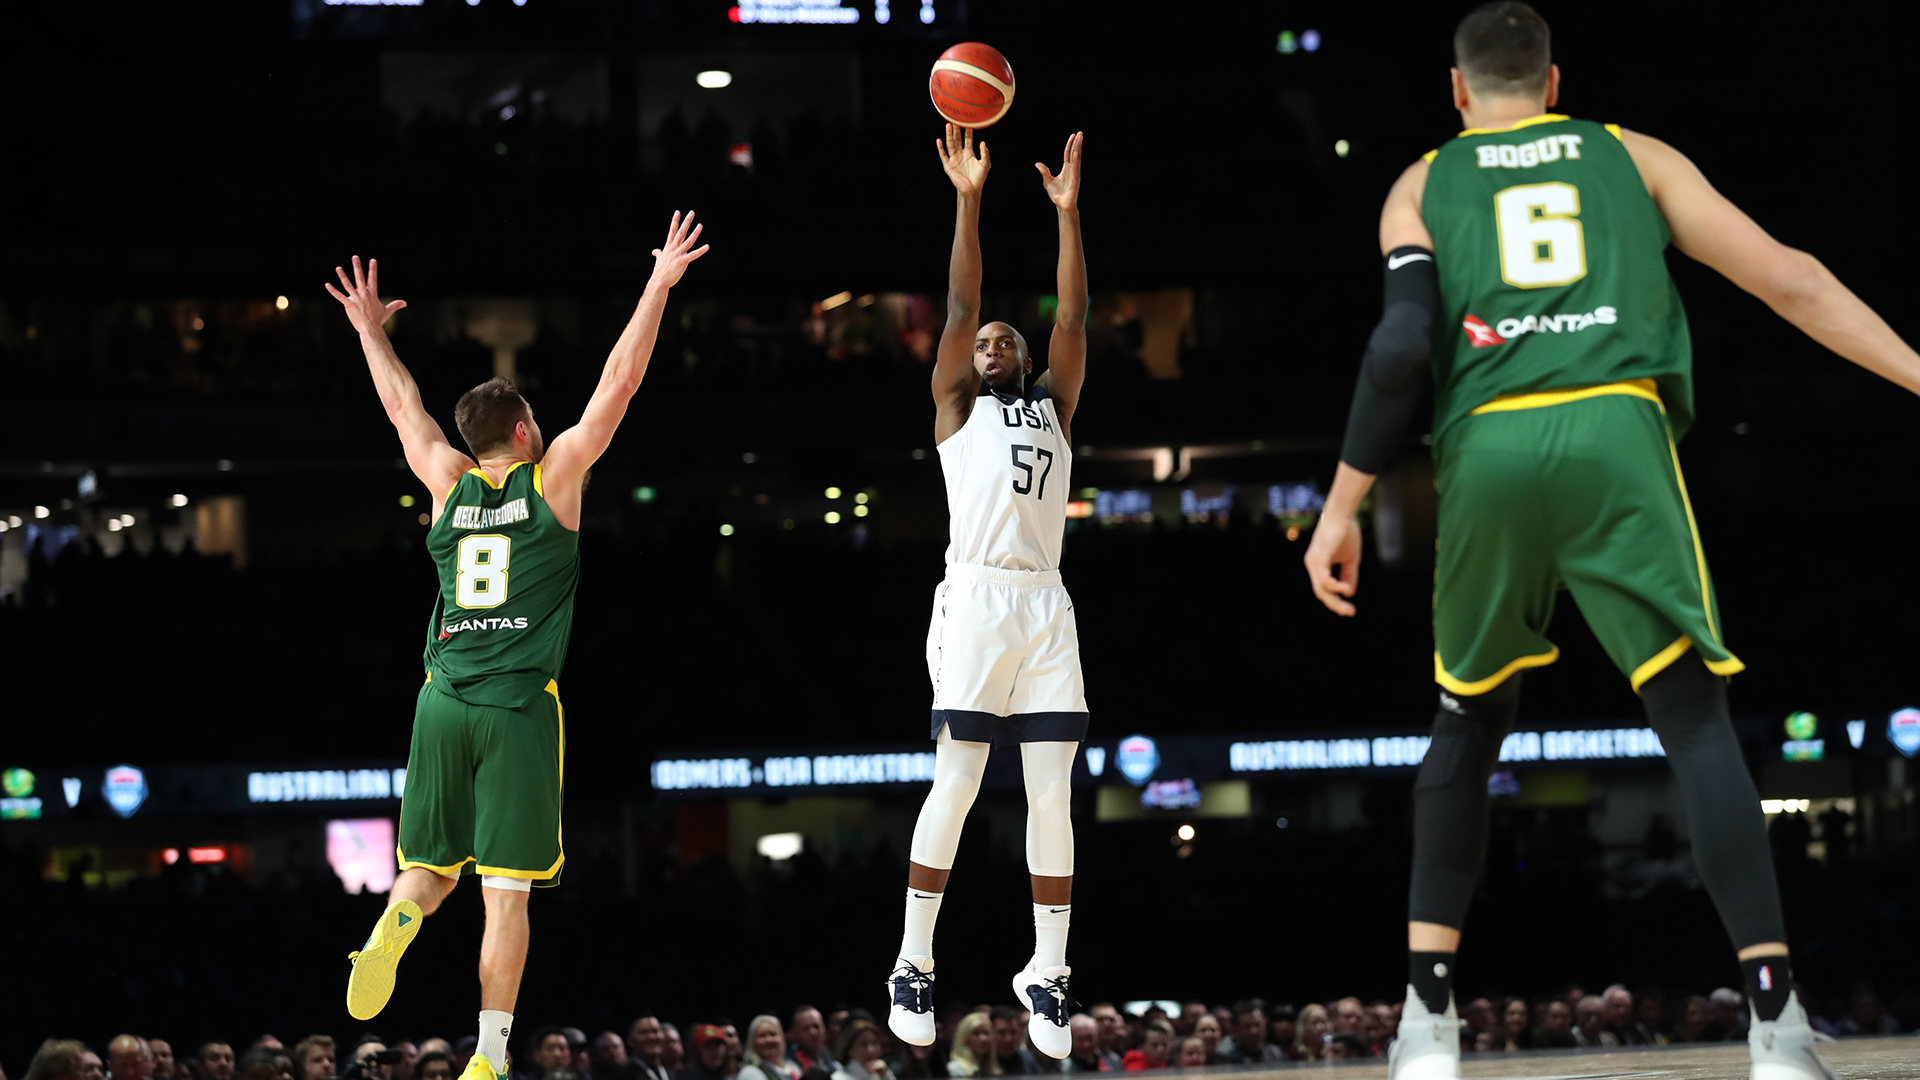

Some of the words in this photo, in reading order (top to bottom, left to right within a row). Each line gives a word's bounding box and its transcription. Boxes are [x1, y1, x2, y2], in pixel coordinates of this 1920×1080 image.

[1476, 134, 1583, 169] BOGUT
[1493, 181, 1588, 289] 6
[1496, 306, 1618, 338] QANTAS
[1002, 406, 1055, 435] USA
[1010, 444, 1054, 501] 57
[452, 497, 530, 530] DELLAVEDOVA
[455, 534, 512, 610] 8
[1230, 740, 1370, 771] AUSTRALIAN
[1543, 728, 1667, 760] BASKETBAL
[248, 769, 391, 802] AUSTRALIAN
[765, 757, 811, 787] USA
[814, 753, 936, 785] BASKETBAL
